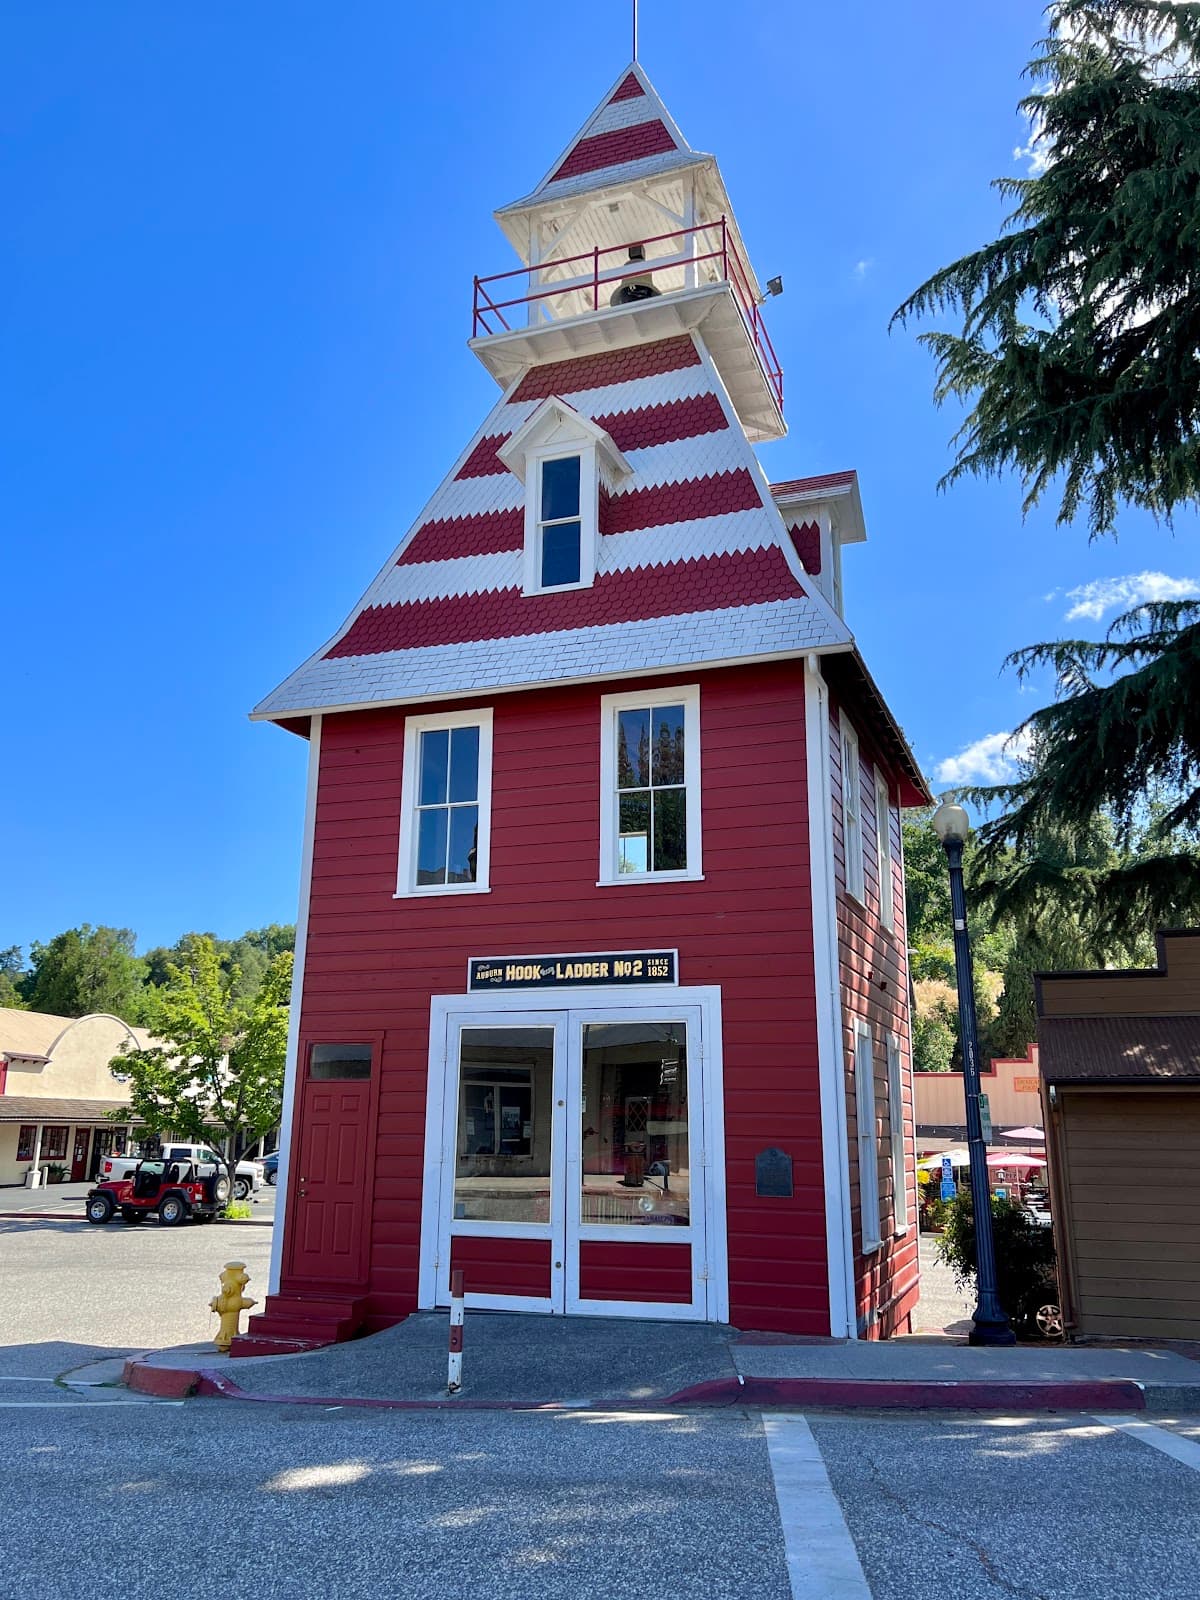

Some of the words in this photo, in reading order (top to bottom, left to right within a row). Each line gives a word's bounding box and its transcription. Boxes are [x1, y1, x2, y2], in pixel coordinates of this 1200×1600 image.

[647, 958, 669, 966] SINCE
[476, 968, 503, 980] AUBURN
[505, 964, 541, 981] HOOK
[556, 962, 609, 979] LADDER
[647, 965, 669, 977] 1852
